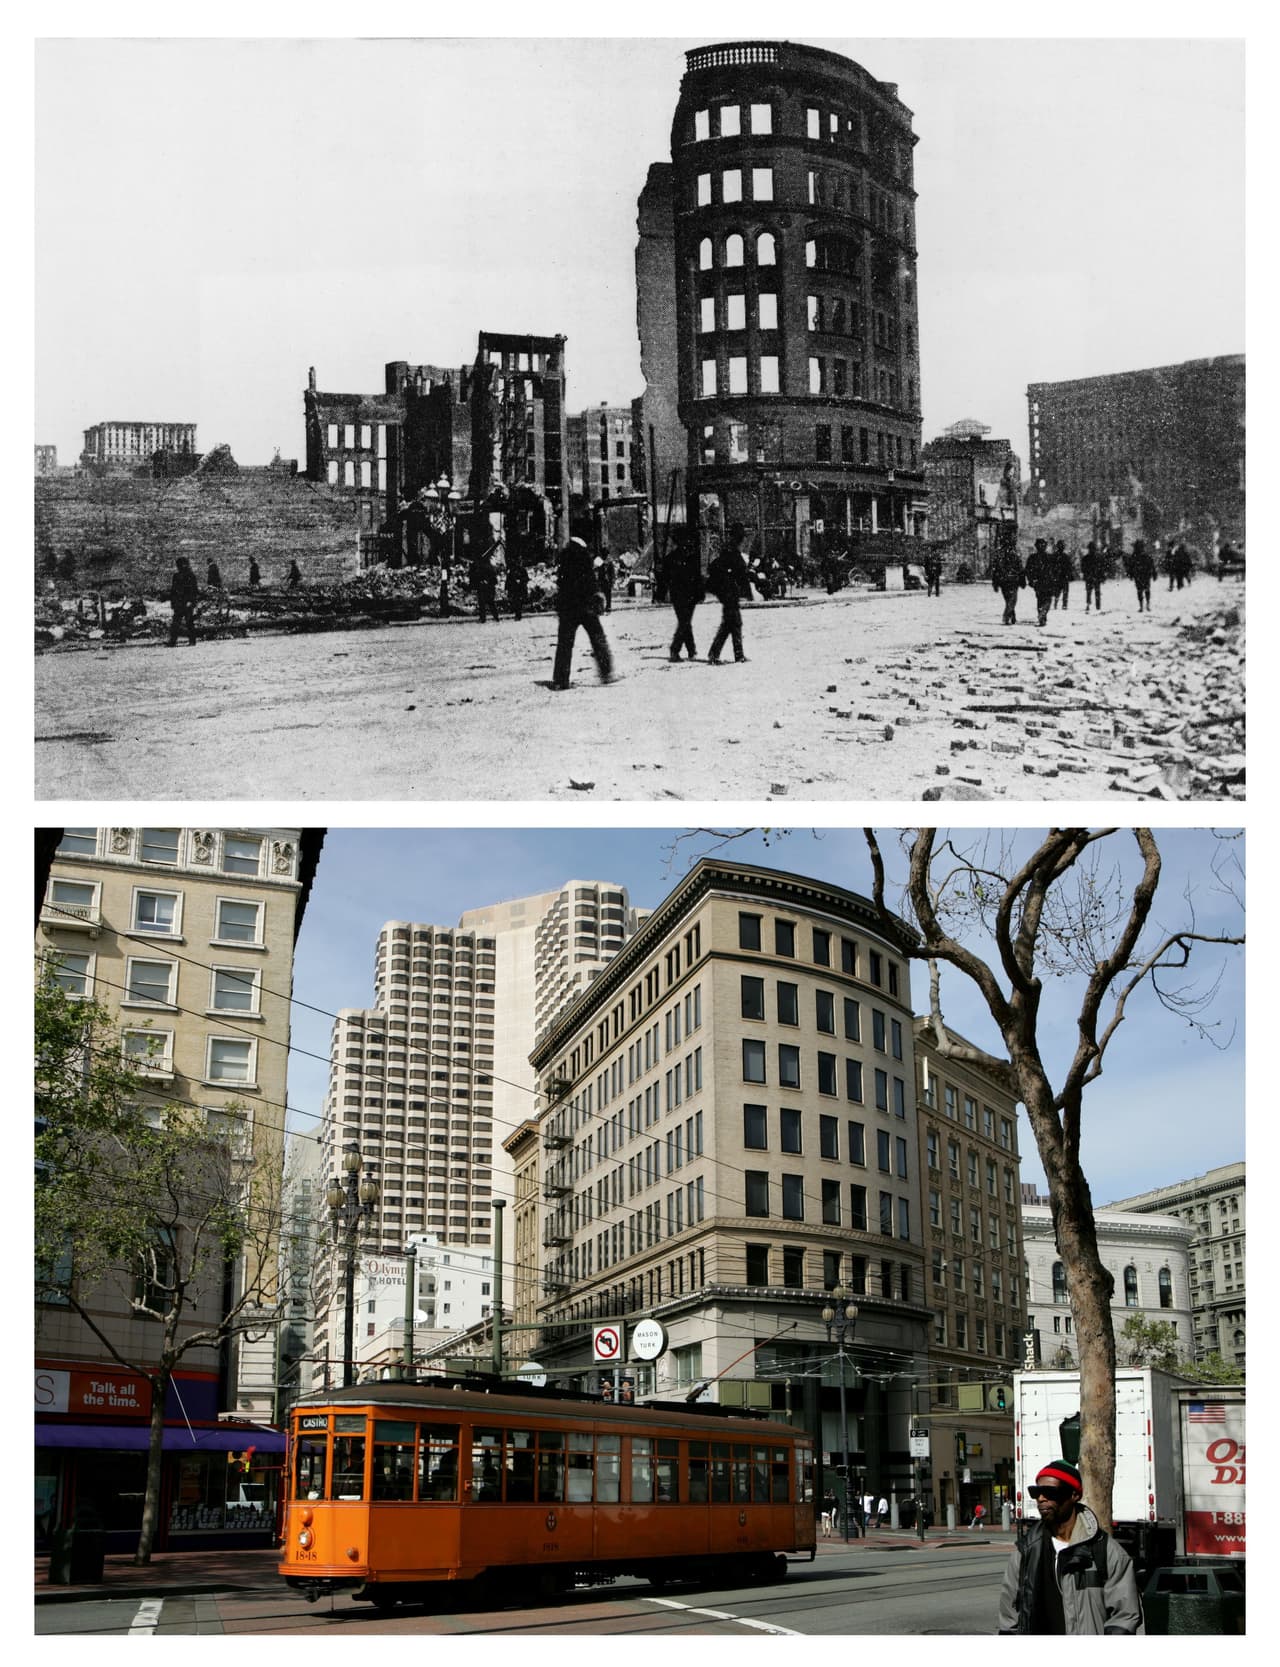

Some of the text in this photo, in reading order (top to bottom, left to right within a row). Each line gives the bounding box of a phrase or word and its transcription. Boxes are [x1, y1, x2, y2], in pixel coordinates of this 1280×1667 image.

[379, 1276, 407, 1286] HOTEL
[1023, 1333, 1035, 1370] Shack
[90, 1381, 136, 1396] Talk all
[83, 1393, 140, 1408] the time.
